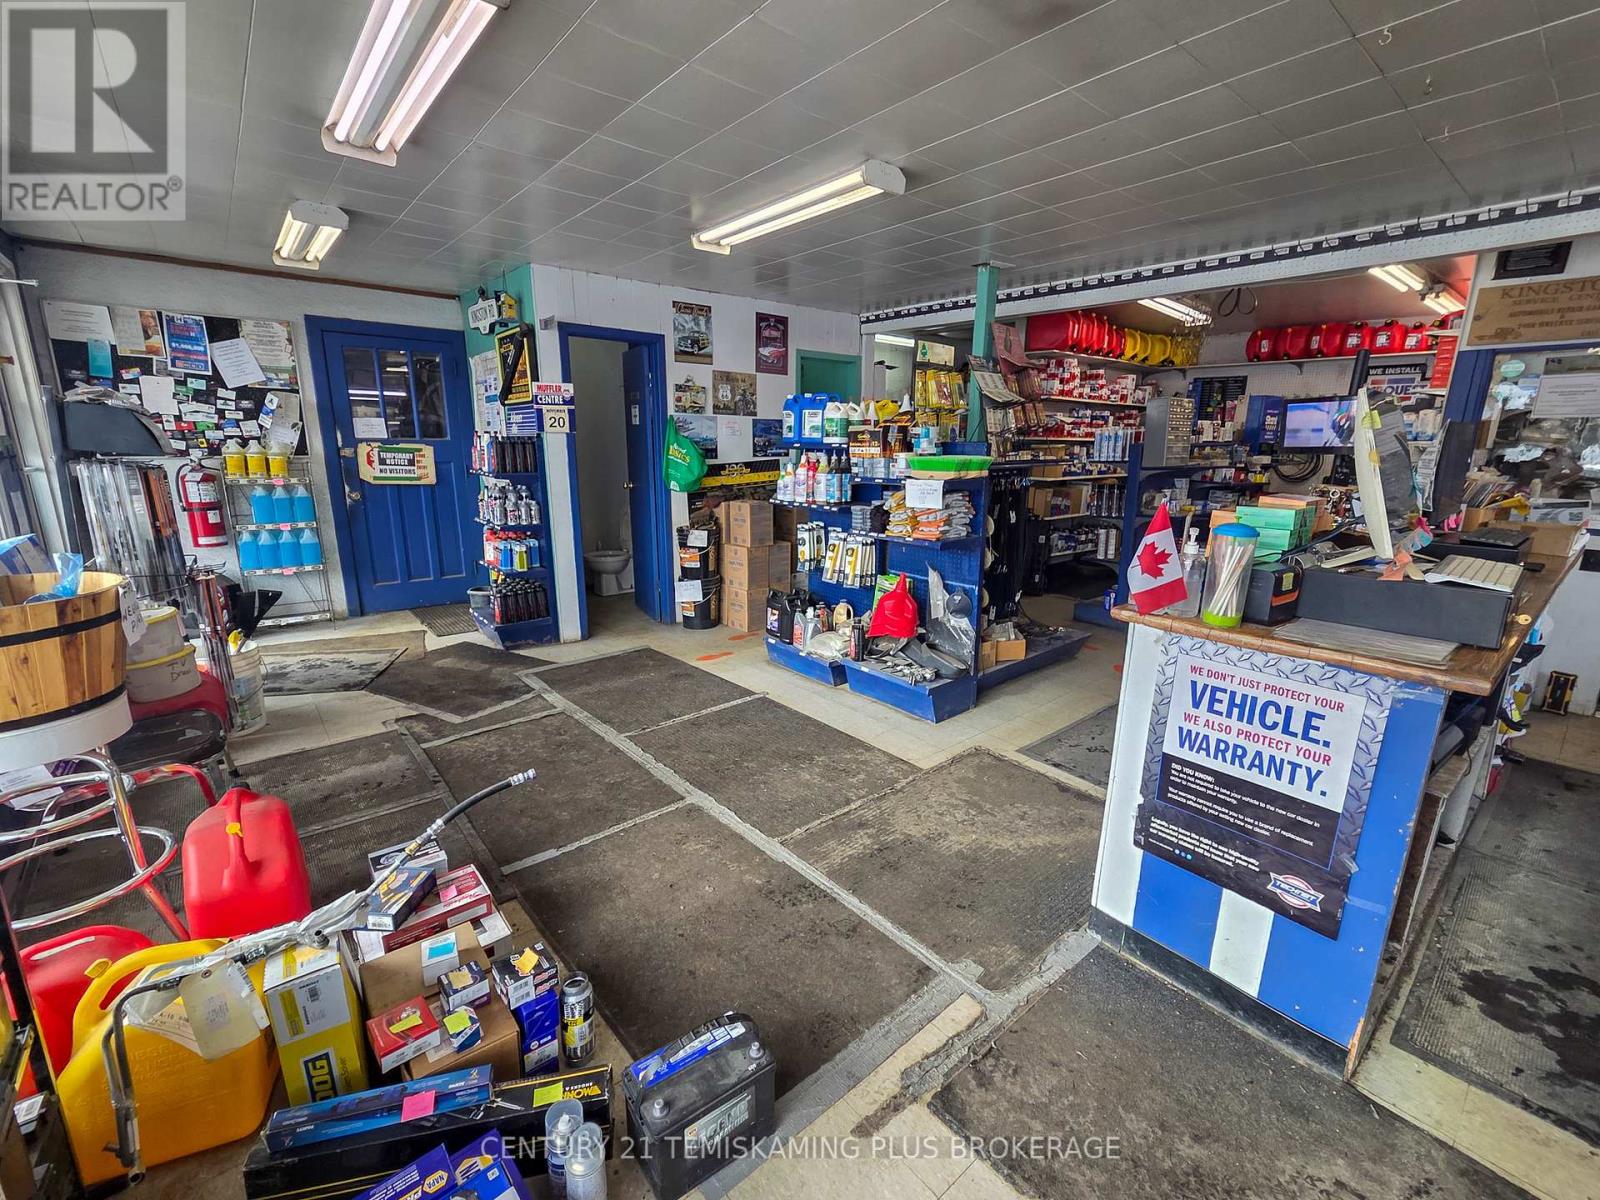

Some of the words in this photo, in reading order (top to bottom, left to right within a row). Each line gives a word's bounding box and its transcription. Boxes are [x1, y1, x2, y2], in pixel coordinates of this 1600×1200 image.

[1369, 367, 1383, 375] WE
[1385, 366, 1422, 375] INSTALL
[536, 384, 562, 393] MUFFLER
[537, 395, 564, 404] CENTRE
[549, 416, 566, 428] 20
[380, 452, 413, 460] TEMPORARY
[386, 458, 408, 466] NOTICE
[389, 467, 416, 475] VISITORS
[1189, 664, 1204, 677] WE
[1206, 668, 1235, 684] DON'T
[1237, 676, 1261, 691] JUST
[1263, 682, 1311, 703] PROTECT
[1312, 694, 1344, 712] YOUR
[1190, 680, 1331, 748] VEHICLE.
[1183, 712, 1200, 726] WE
[1203, 718, 1232, 736] ALSO
[1236, 728, 1291, 754] PROTECT
[1294, 745, 1332, 766] YOUR
[1178, 726, 1327, 797] WARRANTY.
[1171, 762, 1181, 771] DID
[1182, 766, 1194, 775] YOU
[1194, 770, 1215, 782] KNOW:
[426, 1174, 446, 1190] NAPA
